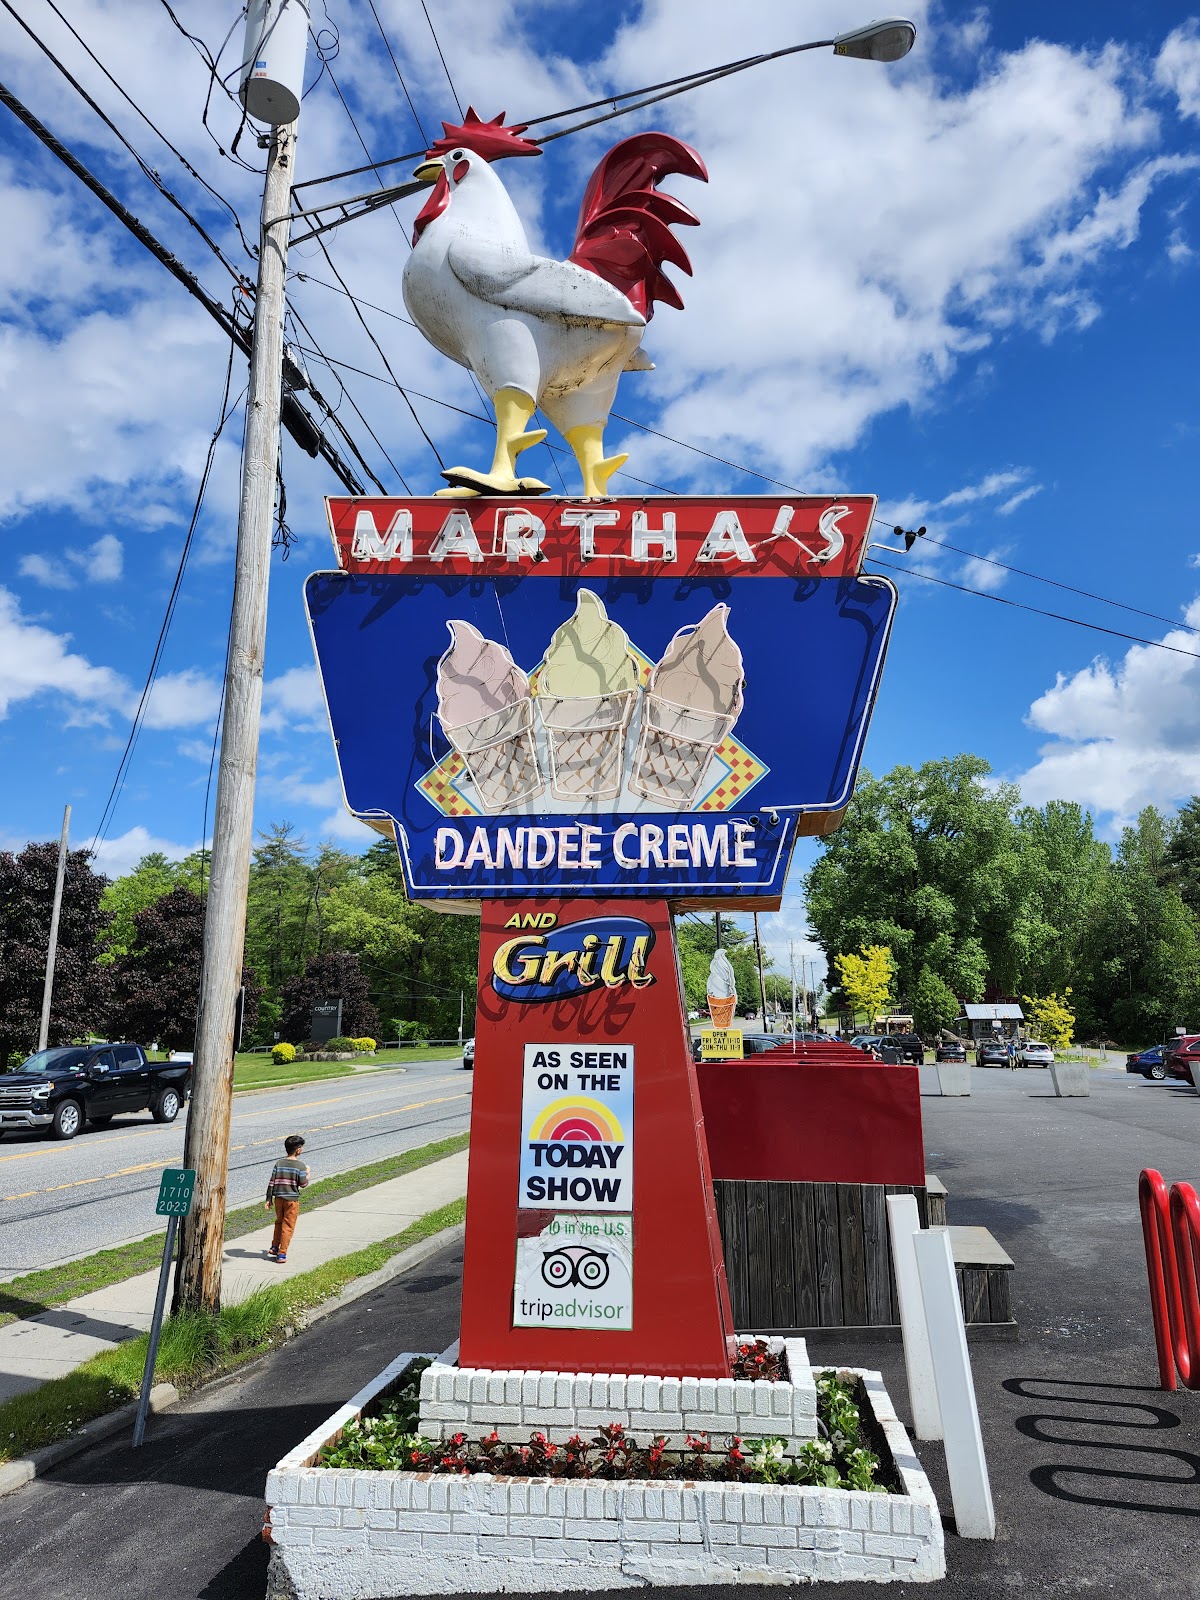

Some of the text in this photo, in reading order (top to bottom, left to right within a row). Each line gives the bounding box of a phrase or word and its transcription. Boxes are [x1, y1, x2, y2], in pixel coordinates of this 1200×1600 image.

[353, 505, 851, 563] MARTHA'S
[435, 823, 757, 870] DANDEE CREME
[504, 912, 557, 929] AND
[493, 935, 654, 989] Grill
[532, 1051, 627, 1069] AS SEEN
[537, 1073, 621, 1091] ON THE
[529, 1143, 624, 1168] TODAY
[162, 1186, 189, 1198] 1710
[526, 1175, 622, 1203] SHOW
[564, 1221, 576, 1235] in
[580, 1222, 600, 1235] the
[603, 1222, 628, 1236] U.S.
[520, 1298, 624, 1321] tripadvisor
